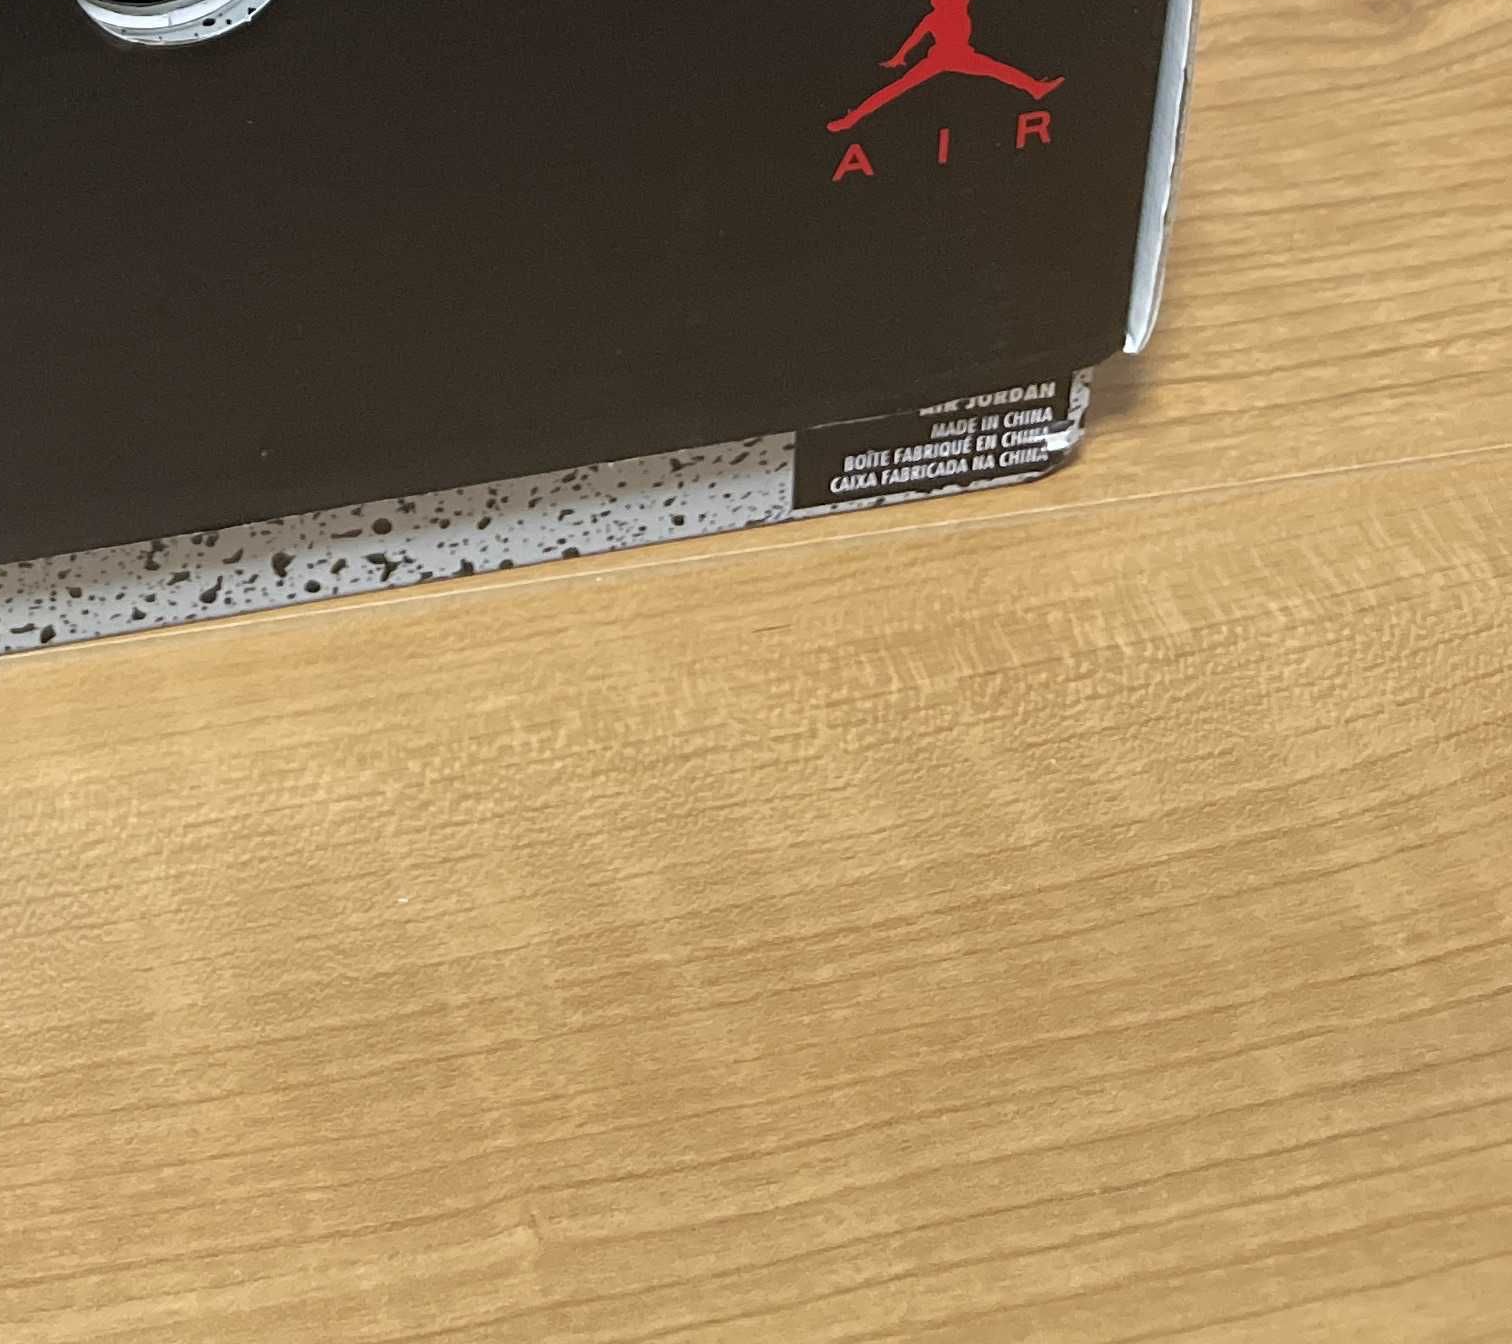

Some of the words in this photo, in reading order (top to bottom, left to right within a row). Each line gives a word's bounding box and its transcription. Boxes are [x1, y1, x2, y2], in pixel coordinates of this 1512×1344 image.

[832, 111, 1051, 182] AIR
[965, 381, 1056, 410] JORDAN
[931, 417, 977, 439] MADE
[981, 414, 999, 431] IN
[1003, 406, 1053, 428] CHINA
[829, 471, 877, 493] CAIXA
[881, 458, 968, 485] FABRICADA
[972, 454, 995, 470] NA
[999, 447, 1048, 467] CHINA
[843, 449, 889, 472] BOÎTE
[893, 434, 972, 464] FABRIQUÉ
[976, 433, 998, 452] EN
